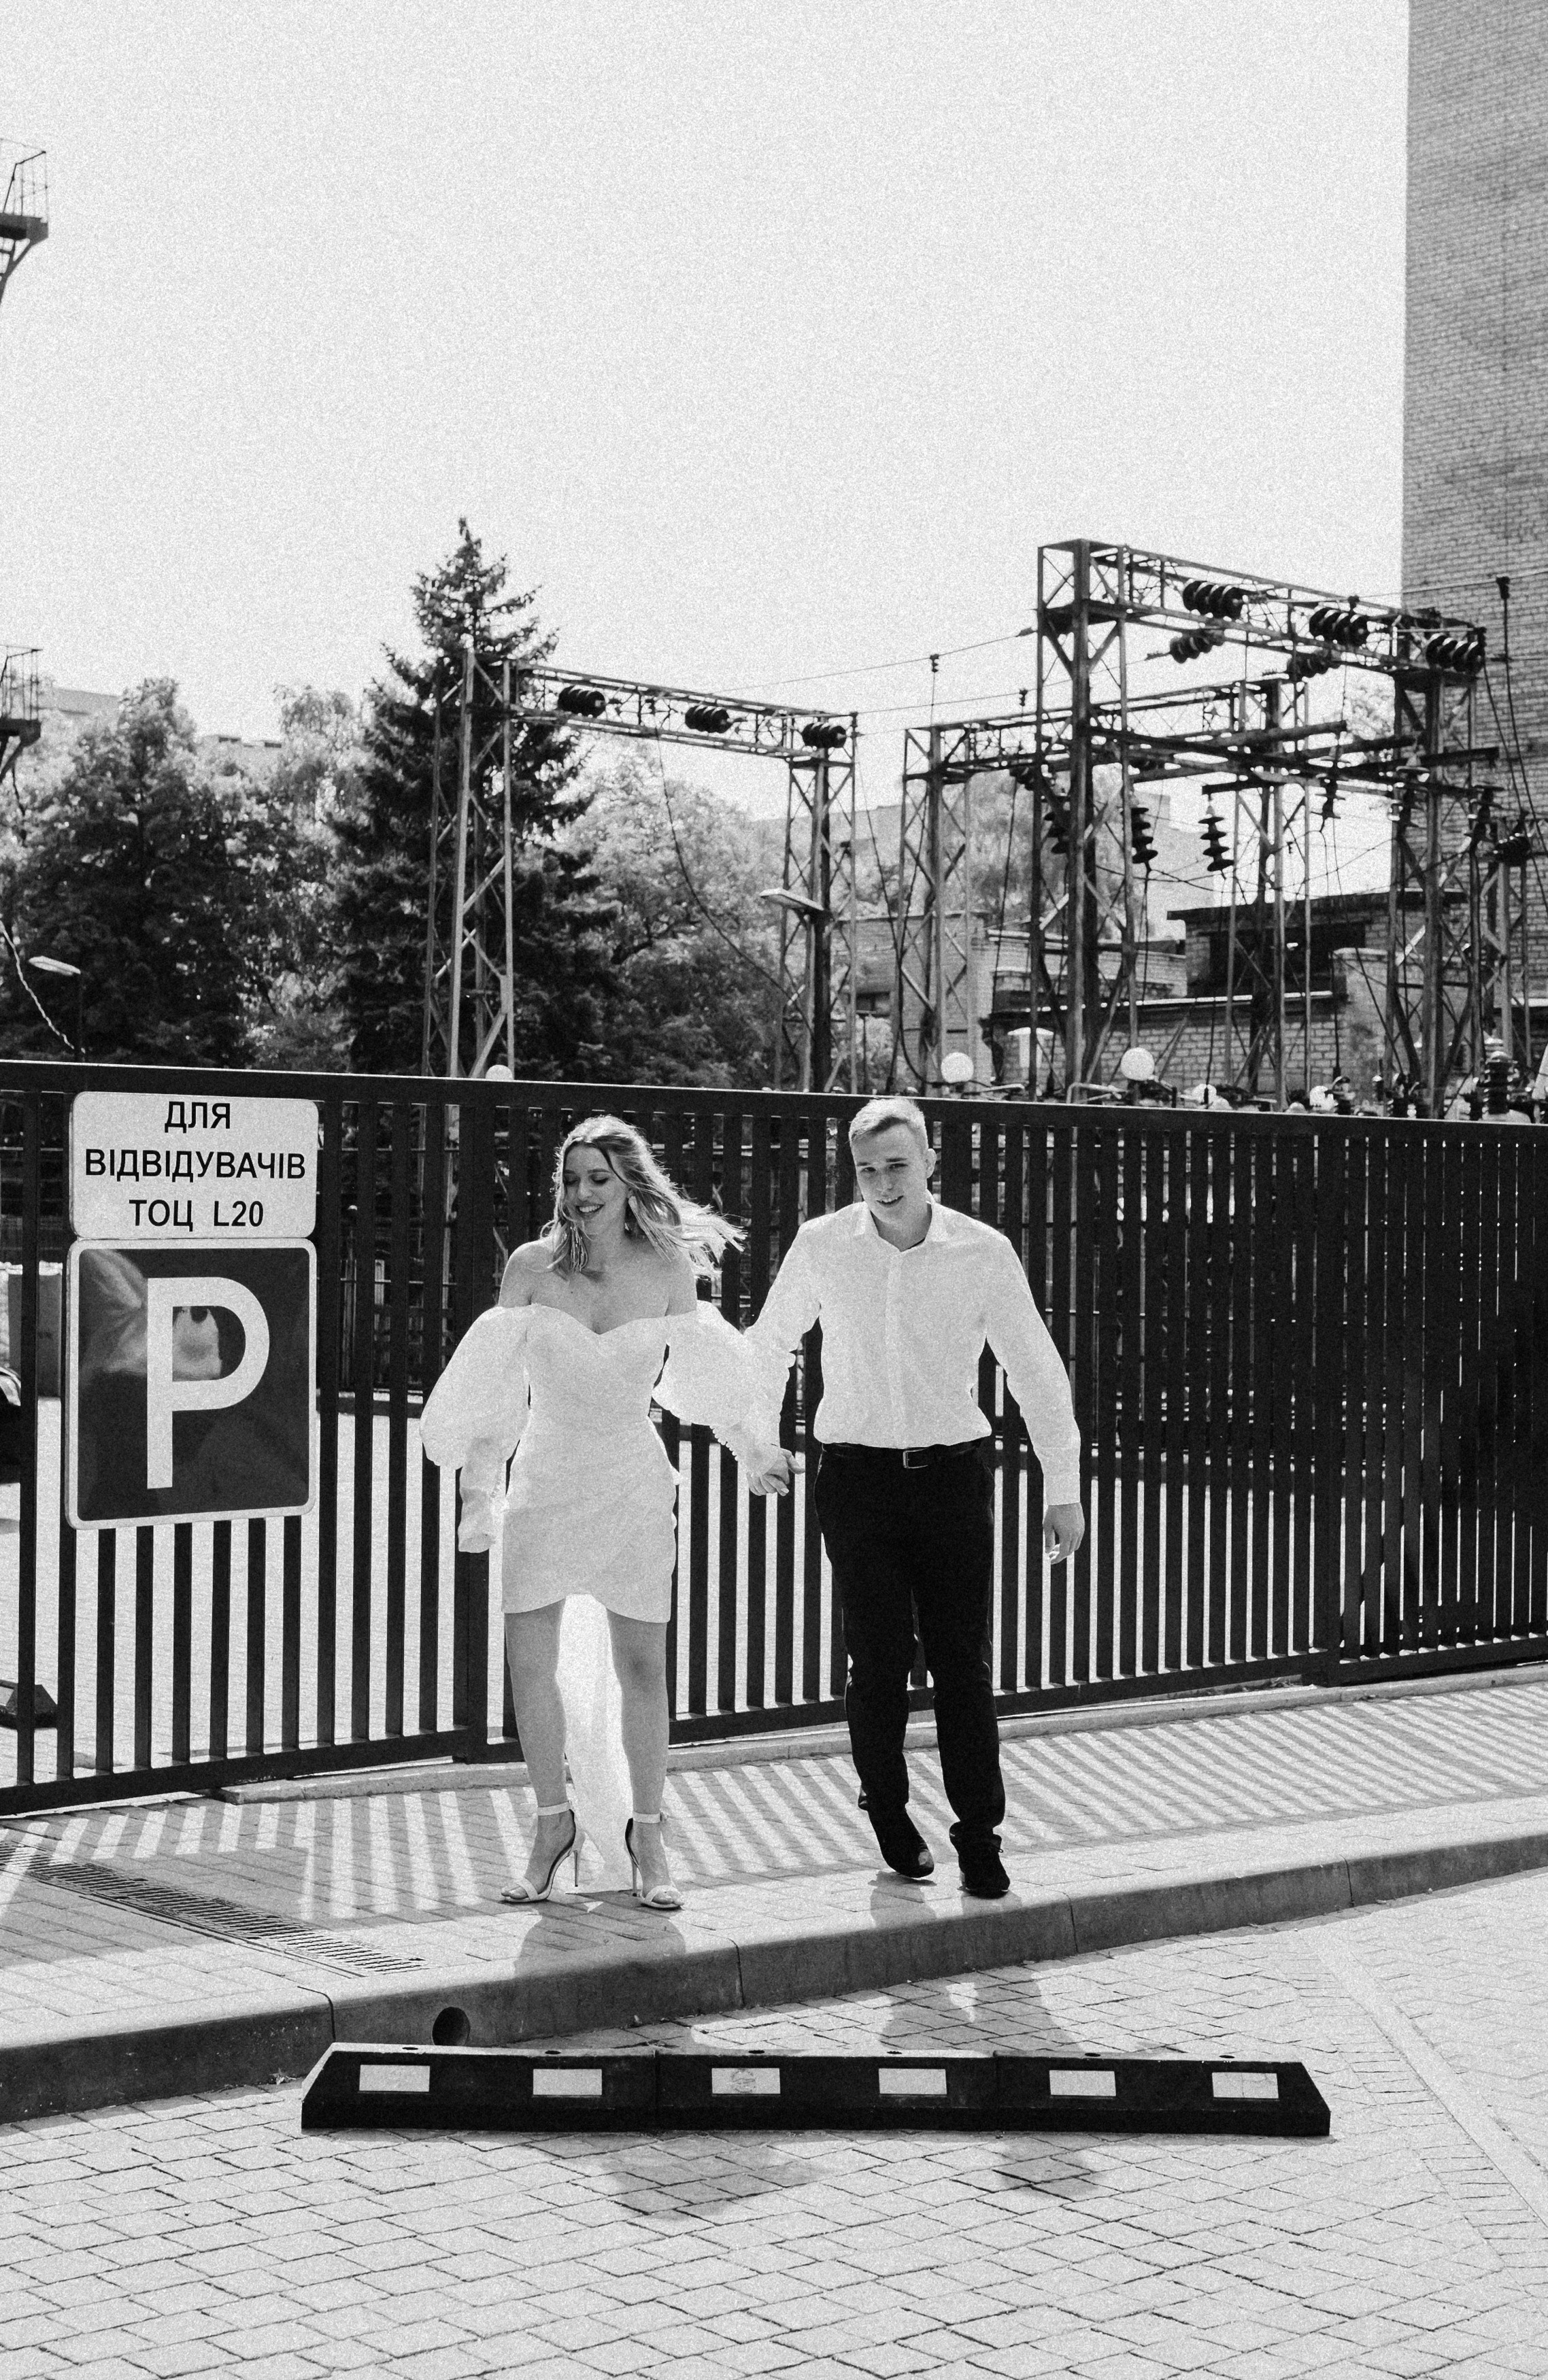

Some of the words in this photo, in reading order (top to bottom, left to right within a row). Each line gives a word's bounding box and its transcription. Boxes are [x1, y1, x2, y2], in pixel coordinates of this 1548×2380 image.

[165, 1101, 231, 1134] ДЛЯ
[86, 1149, 306, 1183] ВІДВІДУВАЧІВ
[129, 1200, 193, 1231] ТОЦ
[214, 1200, 264, 1227] L20
[147, 1276, 270, 1489] P
